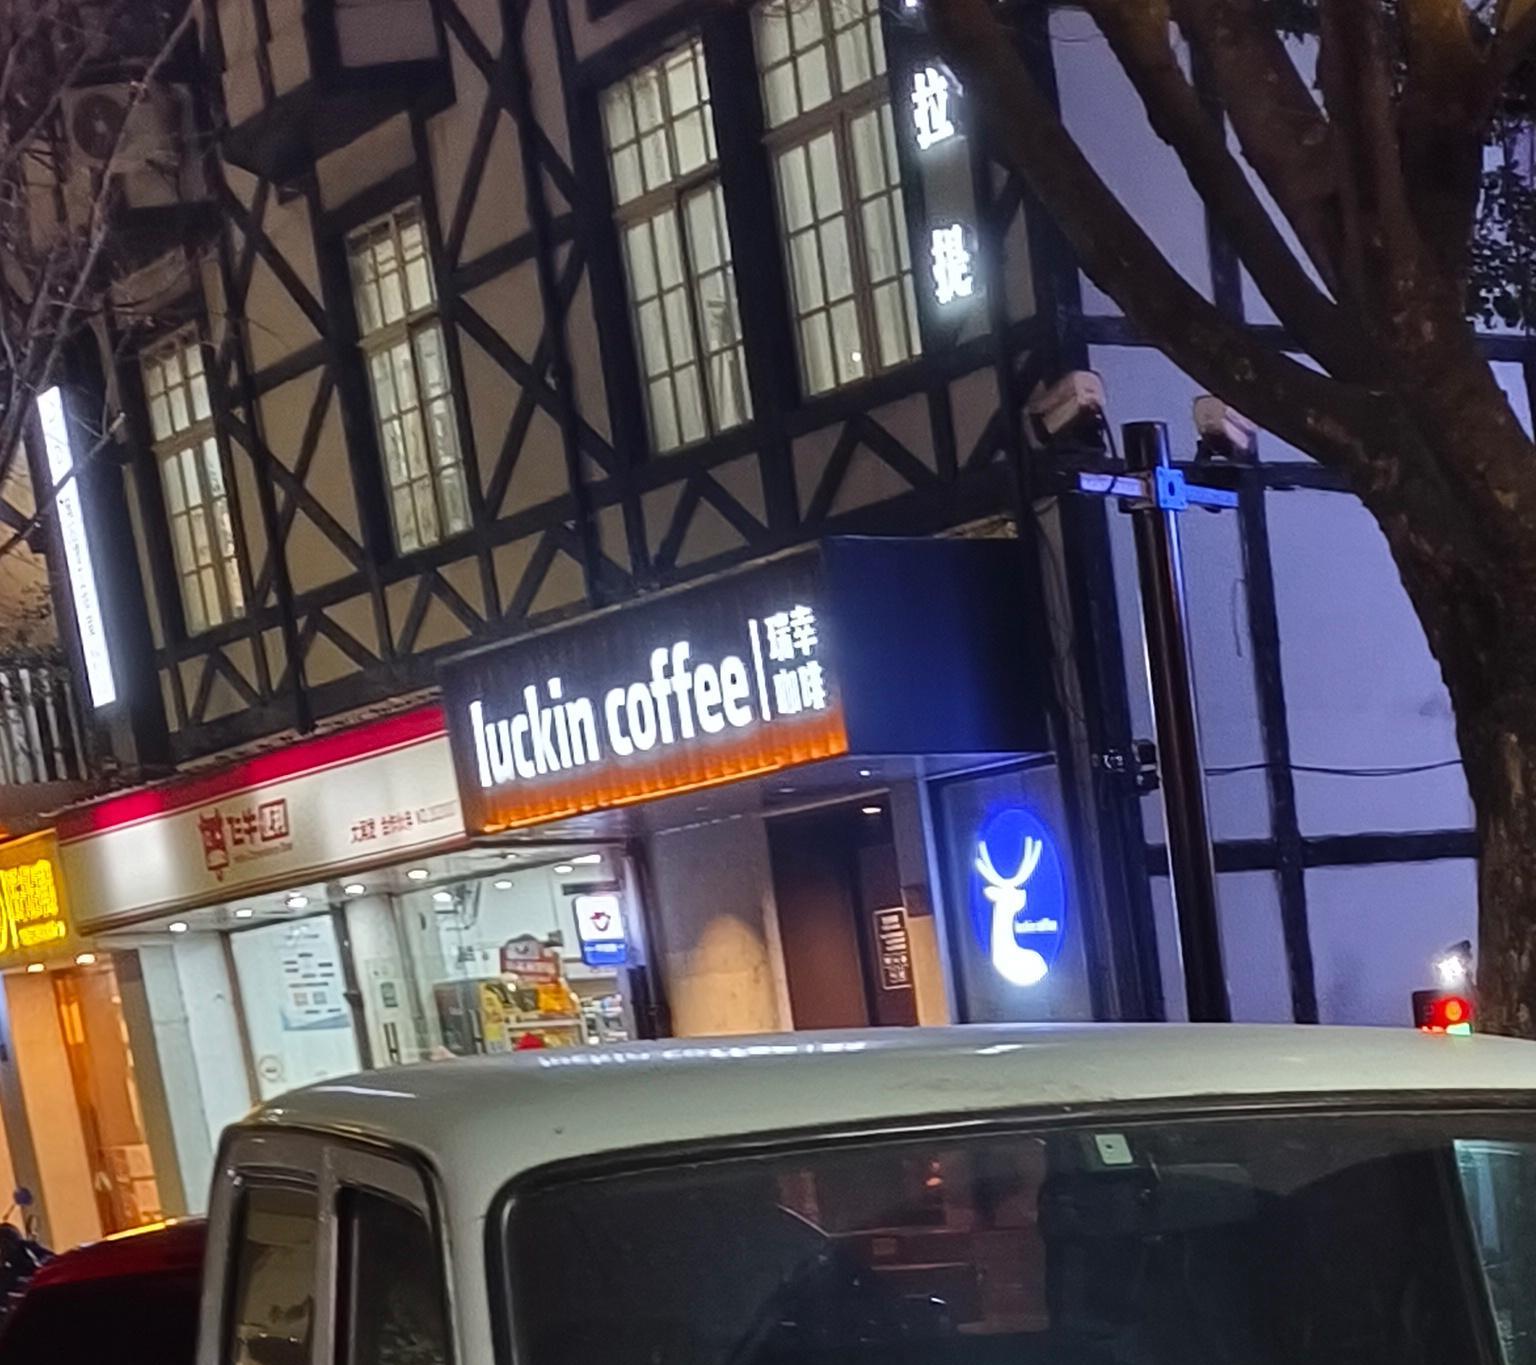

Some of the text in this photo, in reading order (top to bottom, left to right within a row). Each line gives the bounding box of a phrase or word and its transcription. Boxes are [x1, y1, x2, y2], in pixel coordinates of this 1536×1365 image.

[764, 604, 819, 662] 瑞幸
[469, 641, 753, 788] luckin coffee
